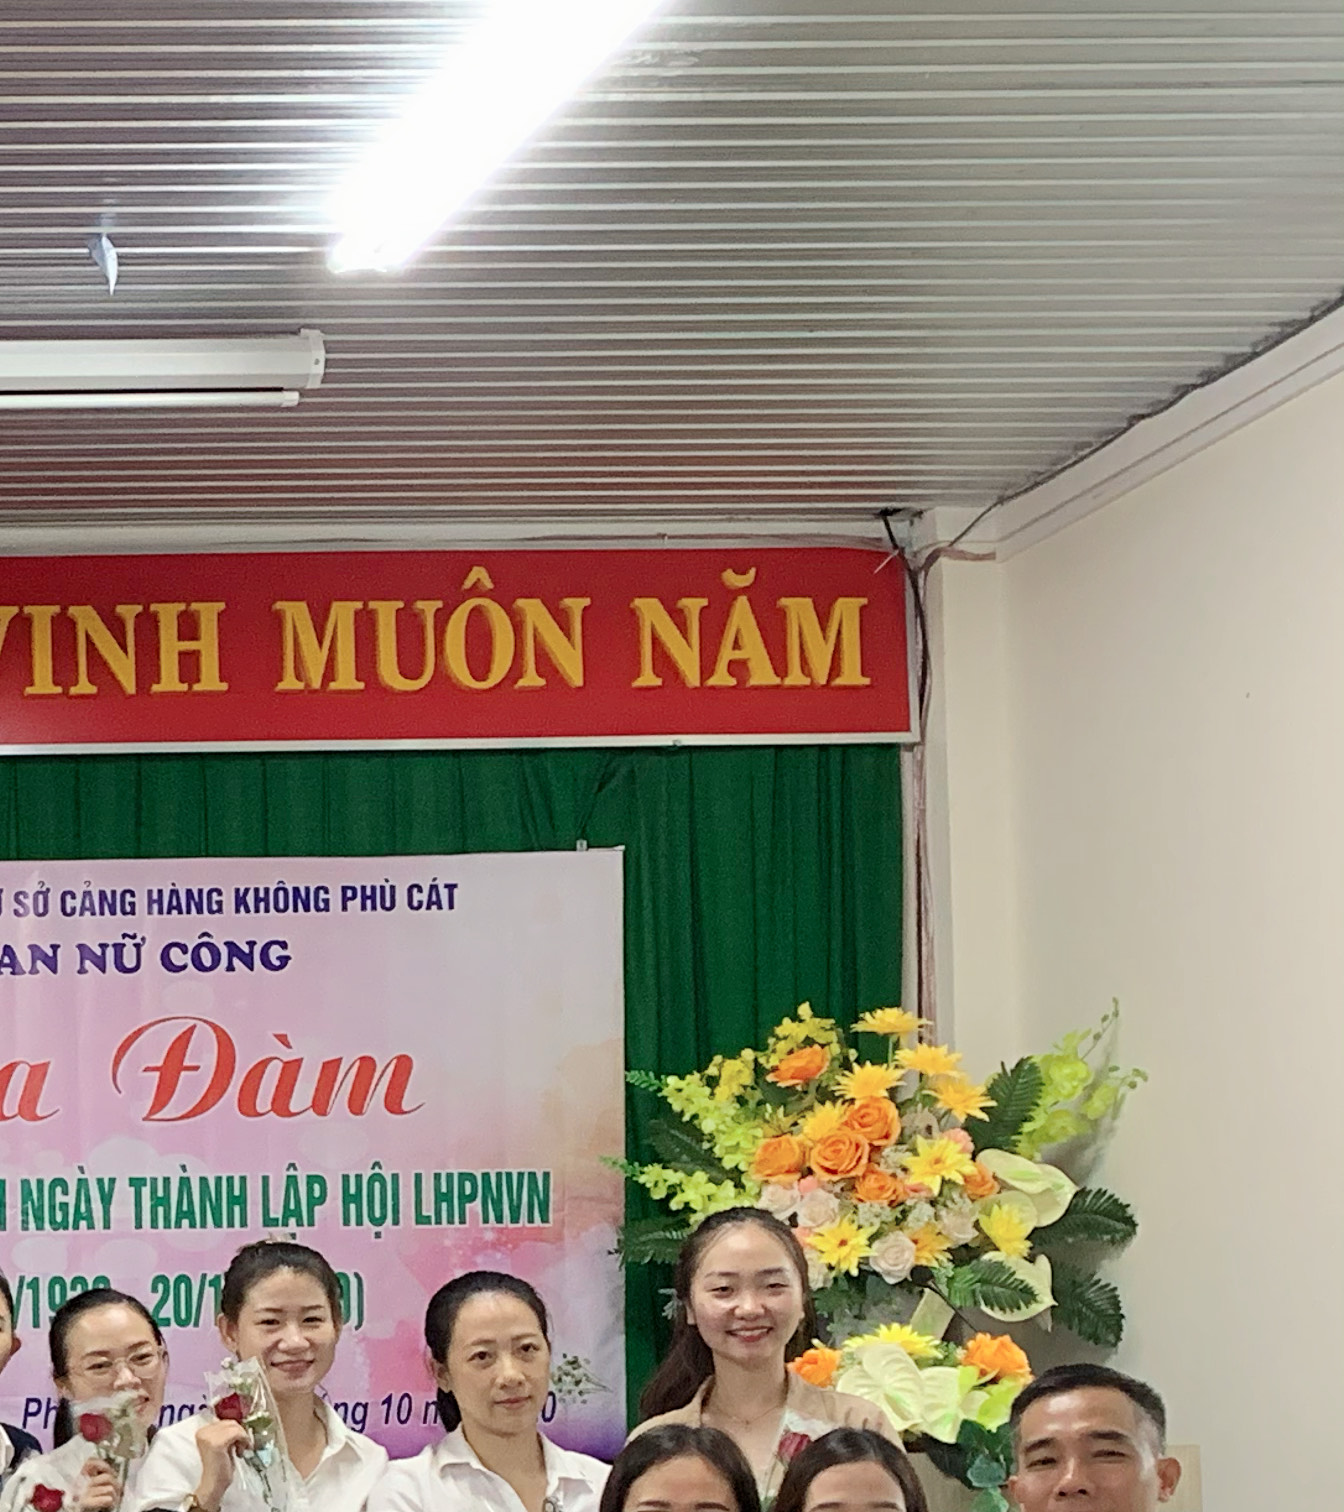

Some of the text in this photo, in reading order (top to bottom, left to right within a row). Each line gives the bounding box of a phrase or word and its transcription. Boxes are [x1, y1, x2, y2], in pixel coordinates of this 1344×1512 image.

[273, 566, 592, 692] MUÔN
[631, 566, 871, 688] NĂM
[12, 880, 51, 918] SỞ
[60, 880, 137, 917] CẢNG
[146, 882, 224, 916] HÀNG
[233, 880, 331, 914] KHÔNG
[339, 878, 397, 912] PHÙ
[406, 876, 459, 912] CÁT
[75, 932, 147, 975] NỮ
[159, 931, 293, 974] CÔNG
[111, 1015, 427, 1123] Đàm
[19, 1165, 117, 1231] NGÀY
[127, 1163, 249, 1230] THÀNH
[260, 1162, 329, 1239] LẬP
[340, 1161, 401, 1239] HỘI
[413, 1170, 551, 1226] LHPNVN
[380, 1391, 413, 1425] 10
